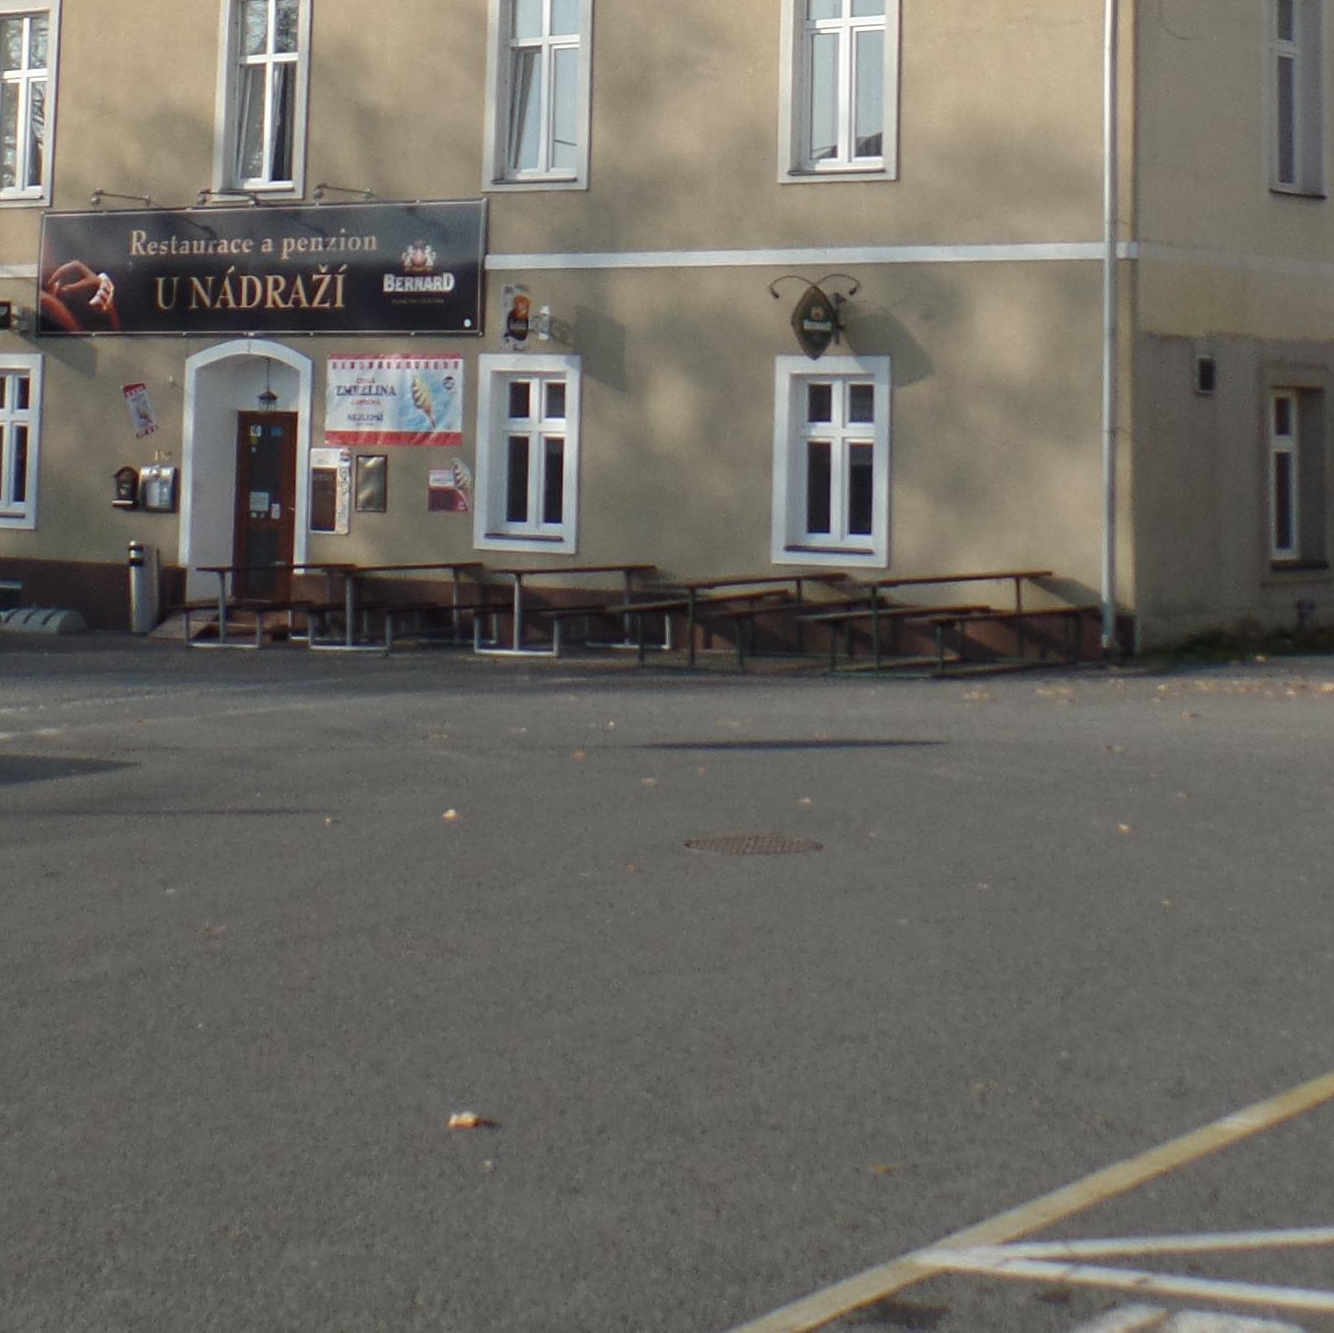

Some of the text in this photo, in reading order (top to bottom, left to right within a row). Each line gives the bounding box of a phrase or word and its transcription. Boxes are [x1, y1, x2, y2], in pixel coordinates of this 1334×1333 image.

[130, 228, 377, 260] Restaurace a penzion
[154, 264, 348, 309] U NÁDRAŽÍ
[382, 272, 455, 293] BERNARD
